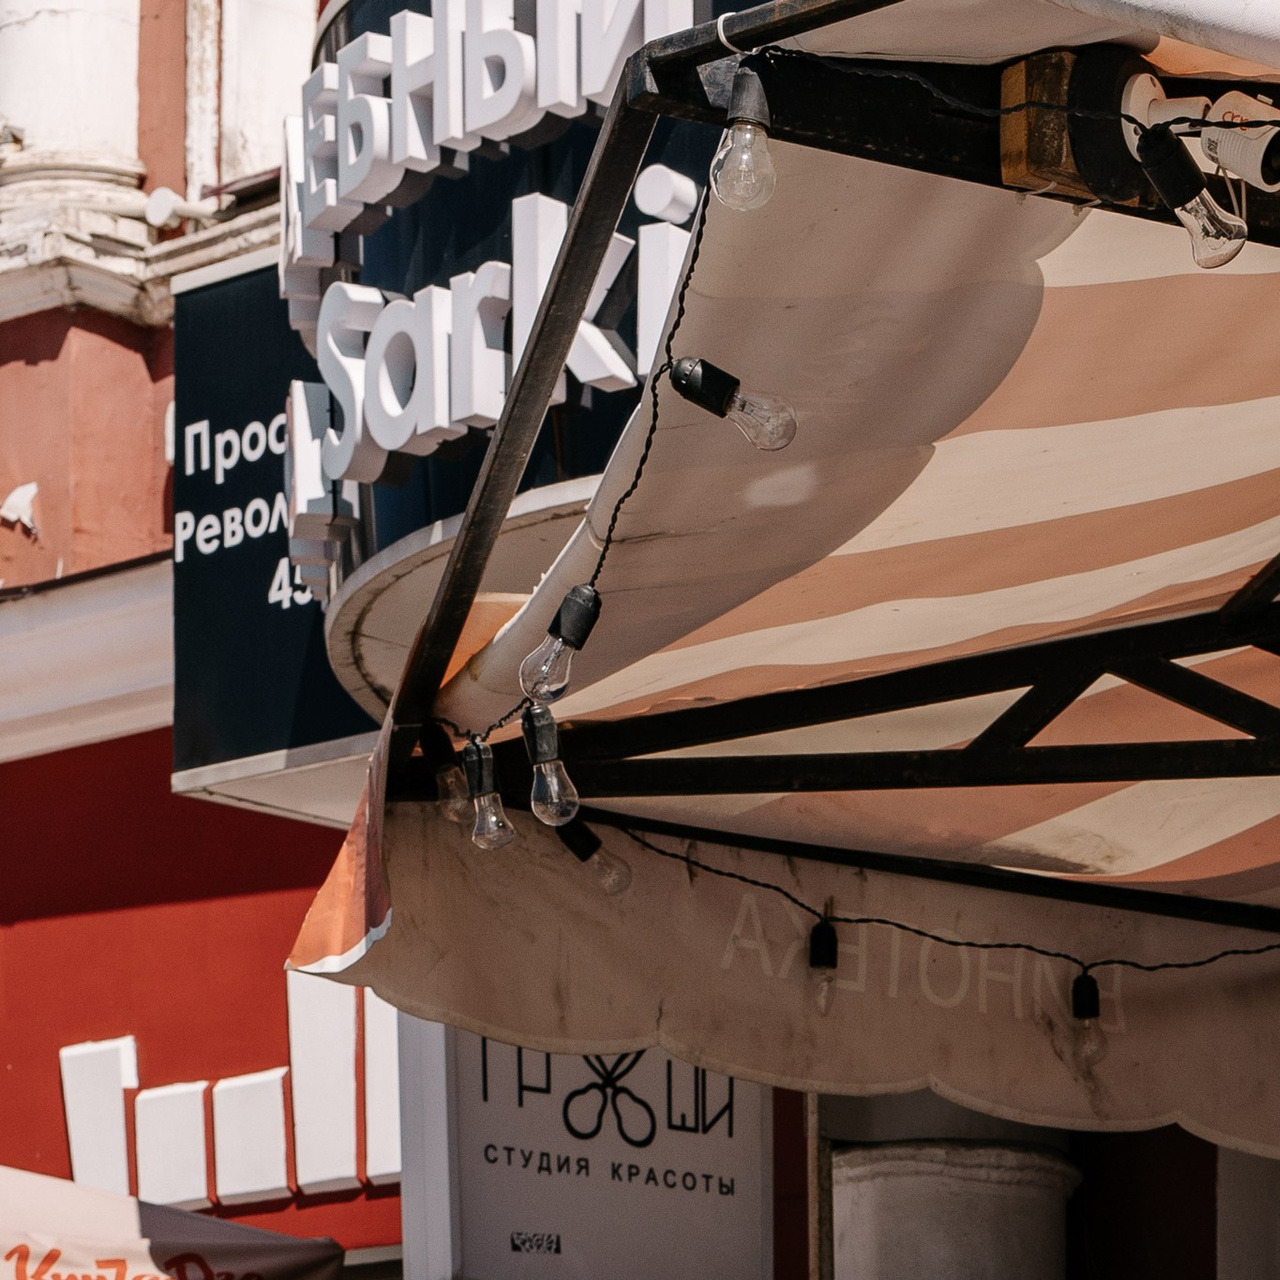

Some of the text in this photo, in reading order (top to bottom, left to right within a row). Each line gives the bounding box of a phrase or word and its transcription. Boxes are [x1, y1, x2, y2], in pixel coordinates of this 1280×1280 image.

[300, 163, 692, 490] Sarki
[484, 1144, 735, 1196] СТУДИЯ КРАСОТЫ
